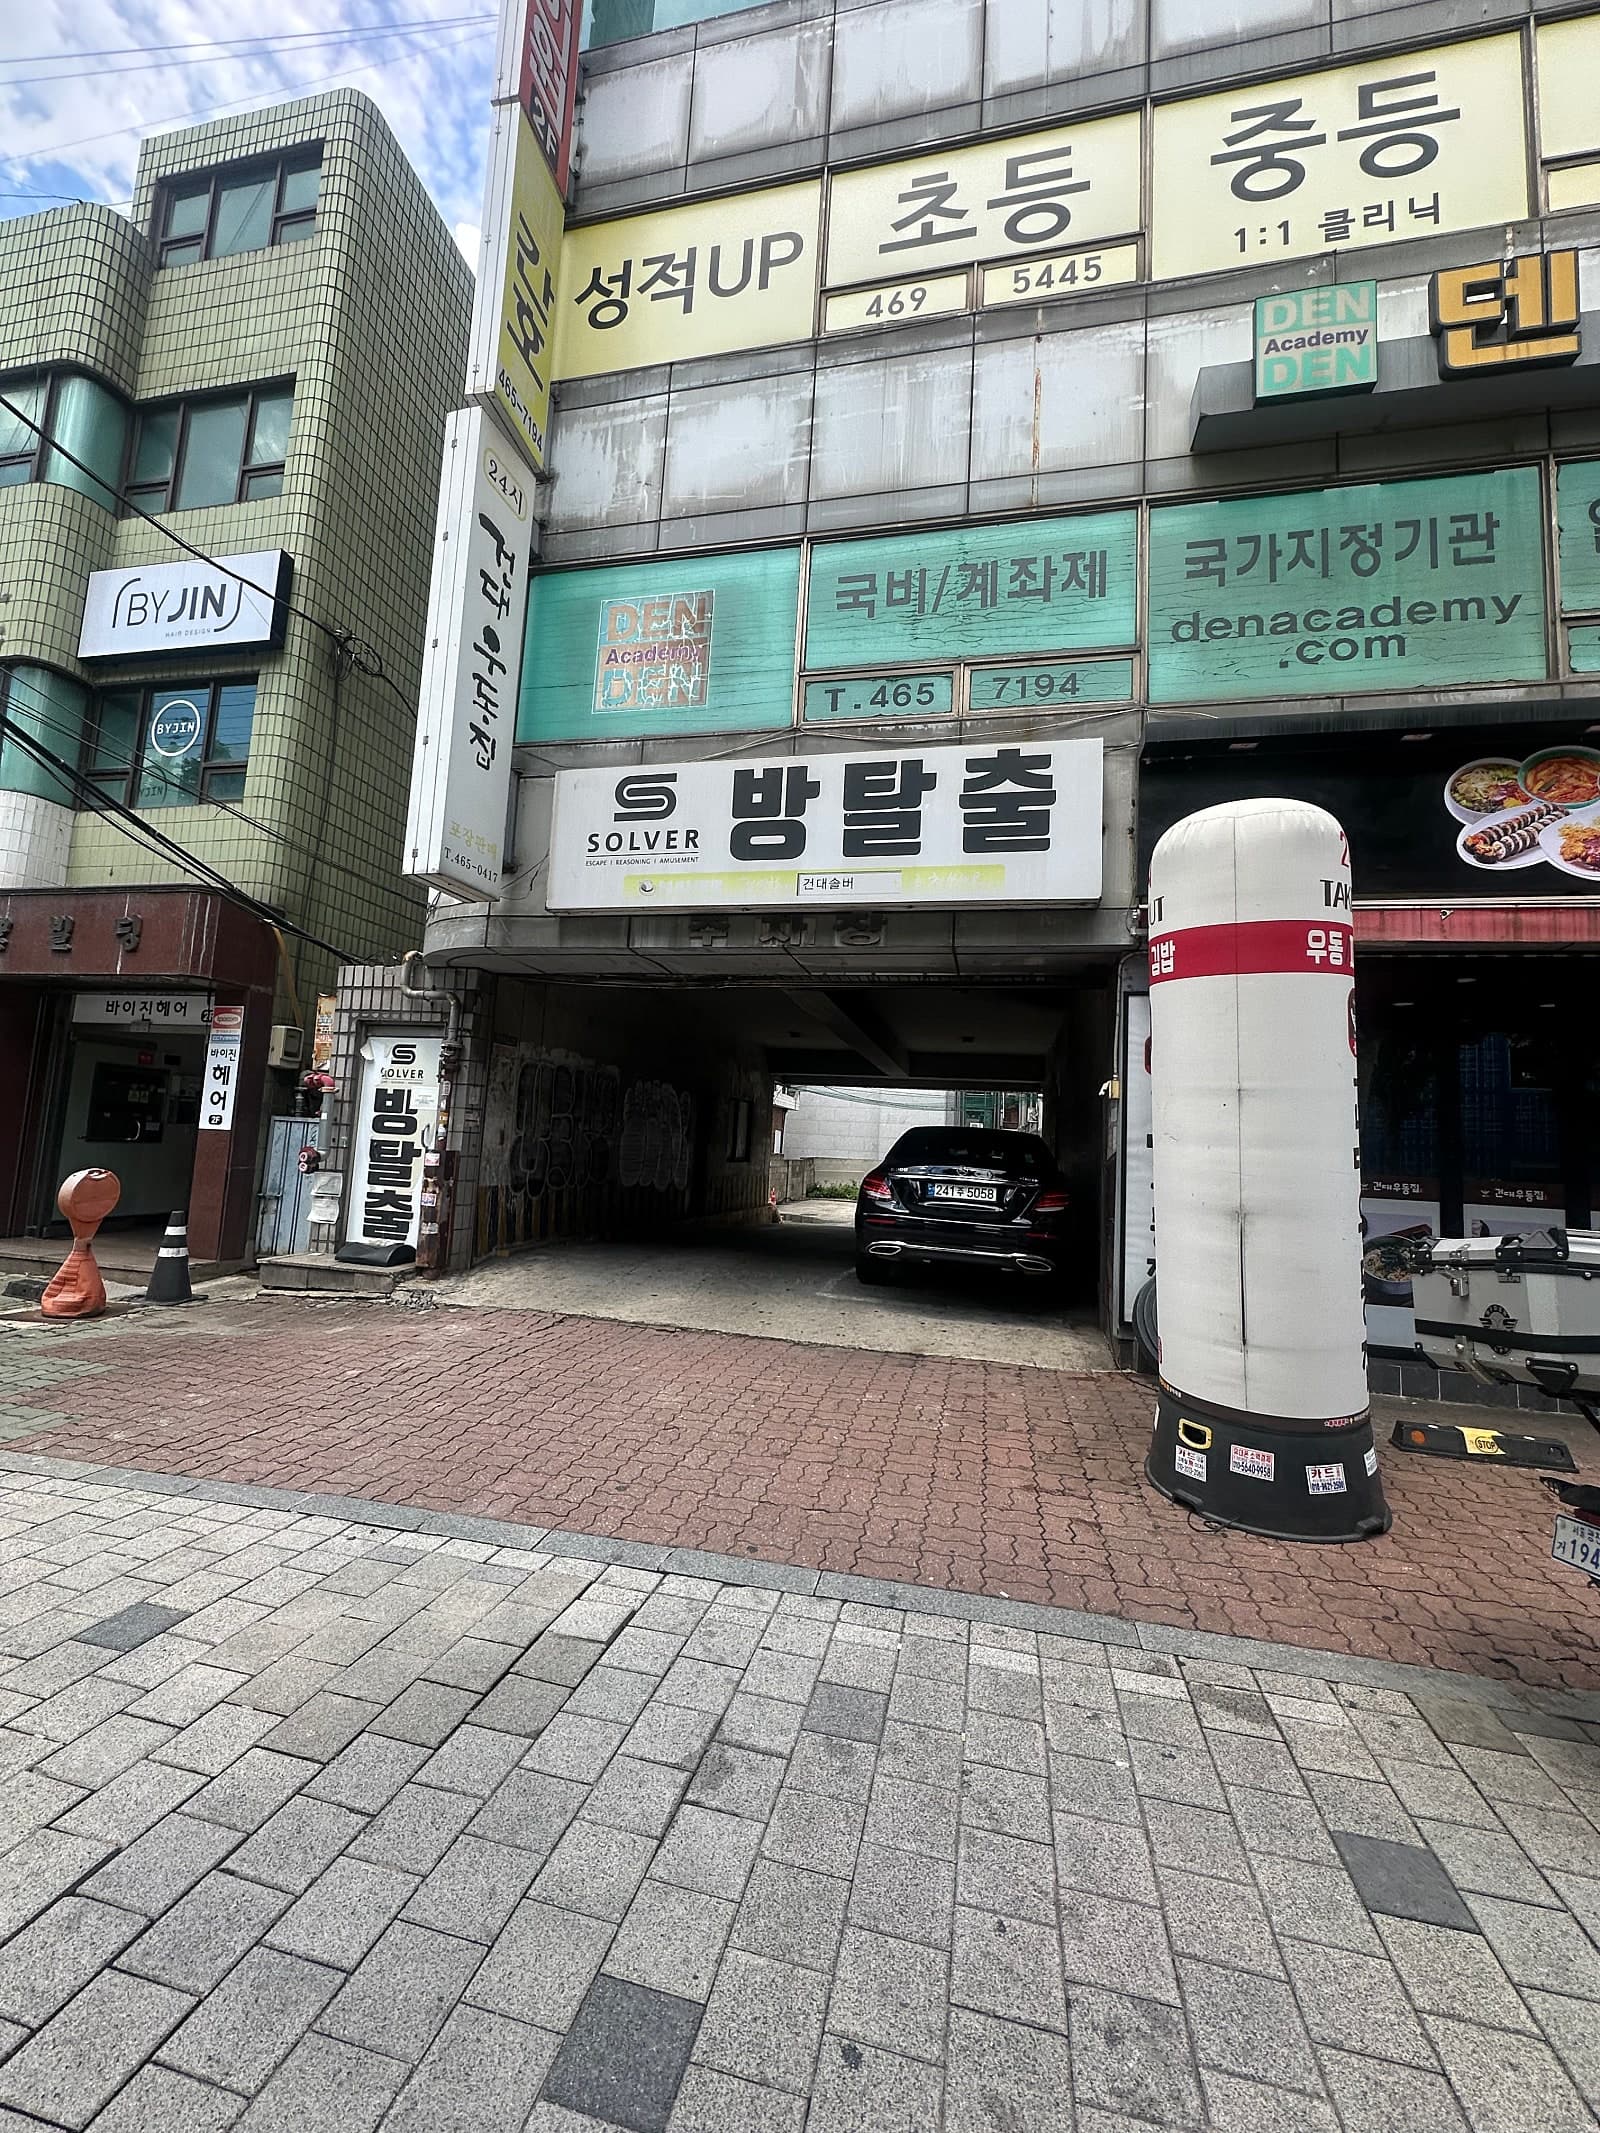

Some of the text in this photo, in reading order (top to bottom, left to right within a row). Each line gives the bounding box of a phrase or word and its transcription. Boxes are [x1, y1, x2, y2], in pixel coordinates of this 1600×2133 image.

[532, 96, 558, 156] 2F
[574, 71, 1460, 330] 성적UP 초등 중등
[1234, 192, 1440, 253] 1:1 클리닉
[506, 211, 554, 392] 간호
[865, 256, 1102, 318] 469 5445
[1263, 286, 1371, 335] DEN
[1264, 328, 1369, 356] Academy
[1263, 345, 1372, 393] DEN
[498, 367, 544, 453] 465-7194
[487, 459, 524, 514] 24시
[1184, 511, 1500, 588] 국가지정기관
[836, 550, 1107, 618] 국비/계좌제
[165, 627, 212, 639] HAIR DESIGN
[607, 597, 706, 642] DEN
[1171, 594, 1523, 644] denacademy
[605, 645, 701, 666] Academy
[1278, 632, 1406, 669] .com
[824, 672, 1080, 712] T.465 7194
[157, 722, 195, 735] BYJIN
[730, 748, 1057, 862] 방탈출
[587, 829, 700, 853] SOLVER
[615, 858, 651, 866] REASONING
[659, 856, 700, 864] AMUSEMENT
[444, 846, 498, 884] T.465-0417
[1151, 940, 1176, 976] 김밥
[1306, 929, 1344, 966] 우동
[105, 1000, 188, 1021] 바이진헤어
[210, 1048, 237, 1062] 바이진
[210, 1064, 231, 1110] 헤어
[210, 1115, 222, 1125] 2F
[362, 1087, 422, 1241] 방탈출
[1477, 1439, 1497, 1449] STOP
[1311, 1467, 1335, 1479] 카드
